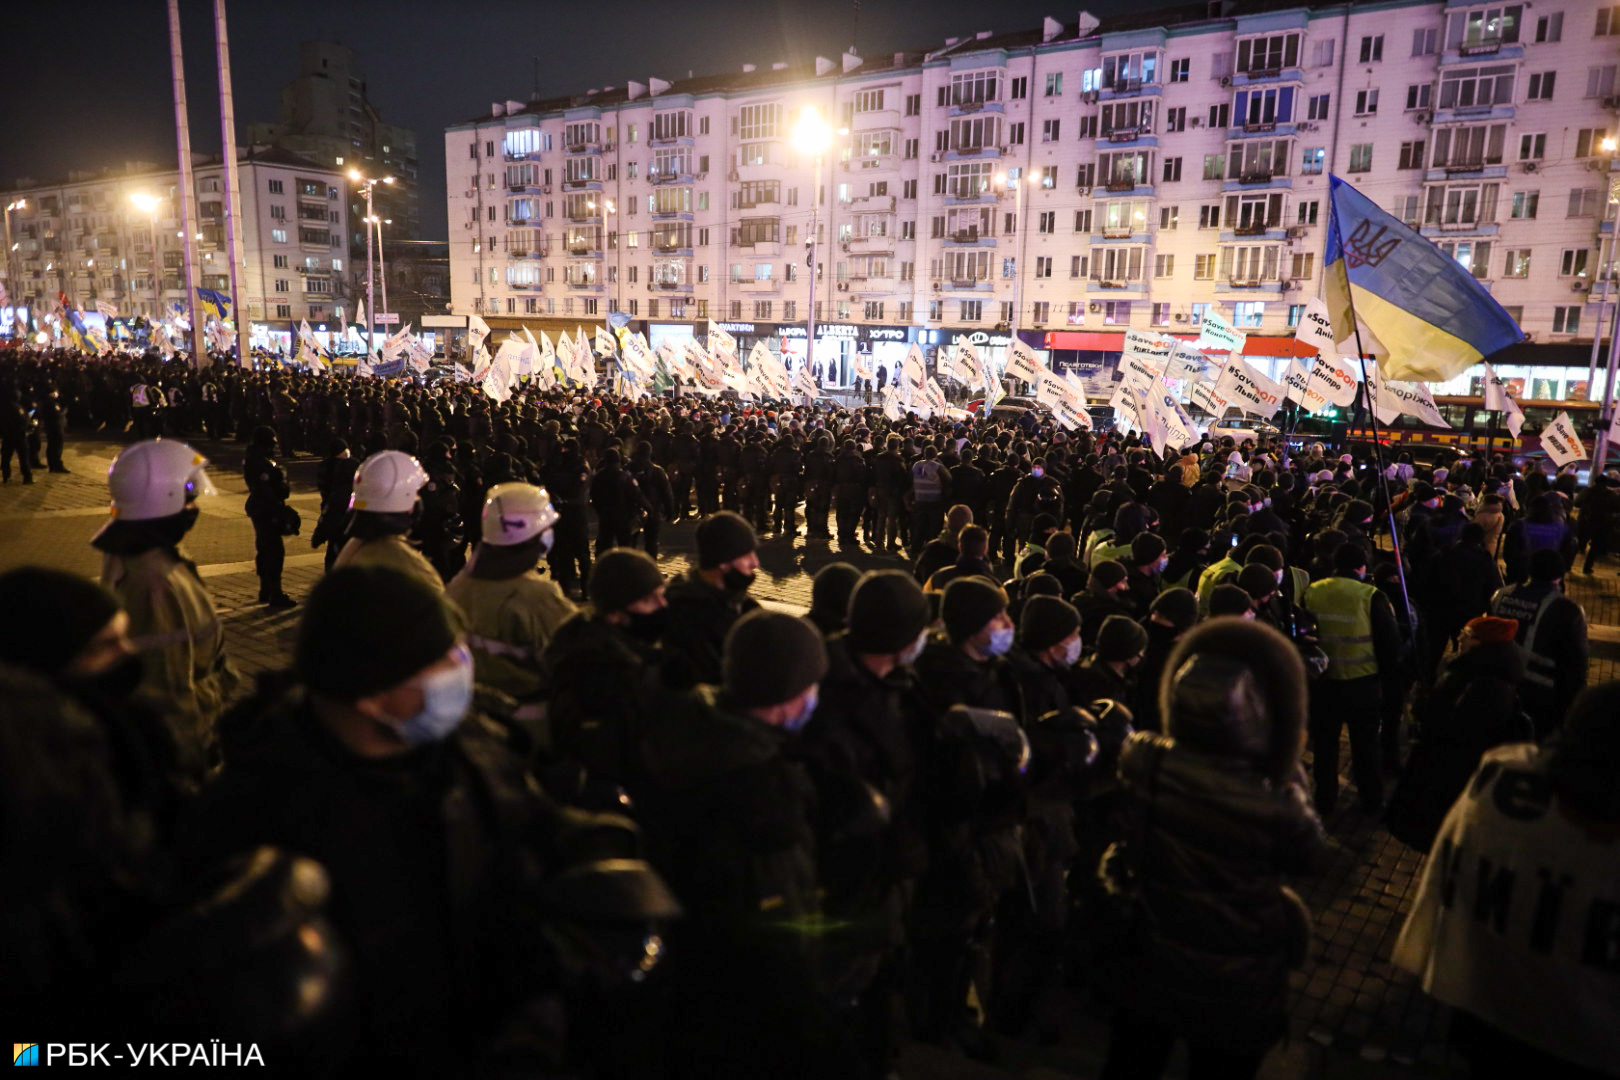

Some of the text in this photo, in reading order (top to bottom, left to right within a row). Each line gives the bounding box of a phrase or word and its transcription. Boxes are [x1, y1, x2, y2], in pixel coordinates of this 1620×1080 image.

[1127, 334, 1172, 349] #SaveФО
[1311, 368, 1342, 391] Дніпро
[1234, 384, 1261, 404] Львів
